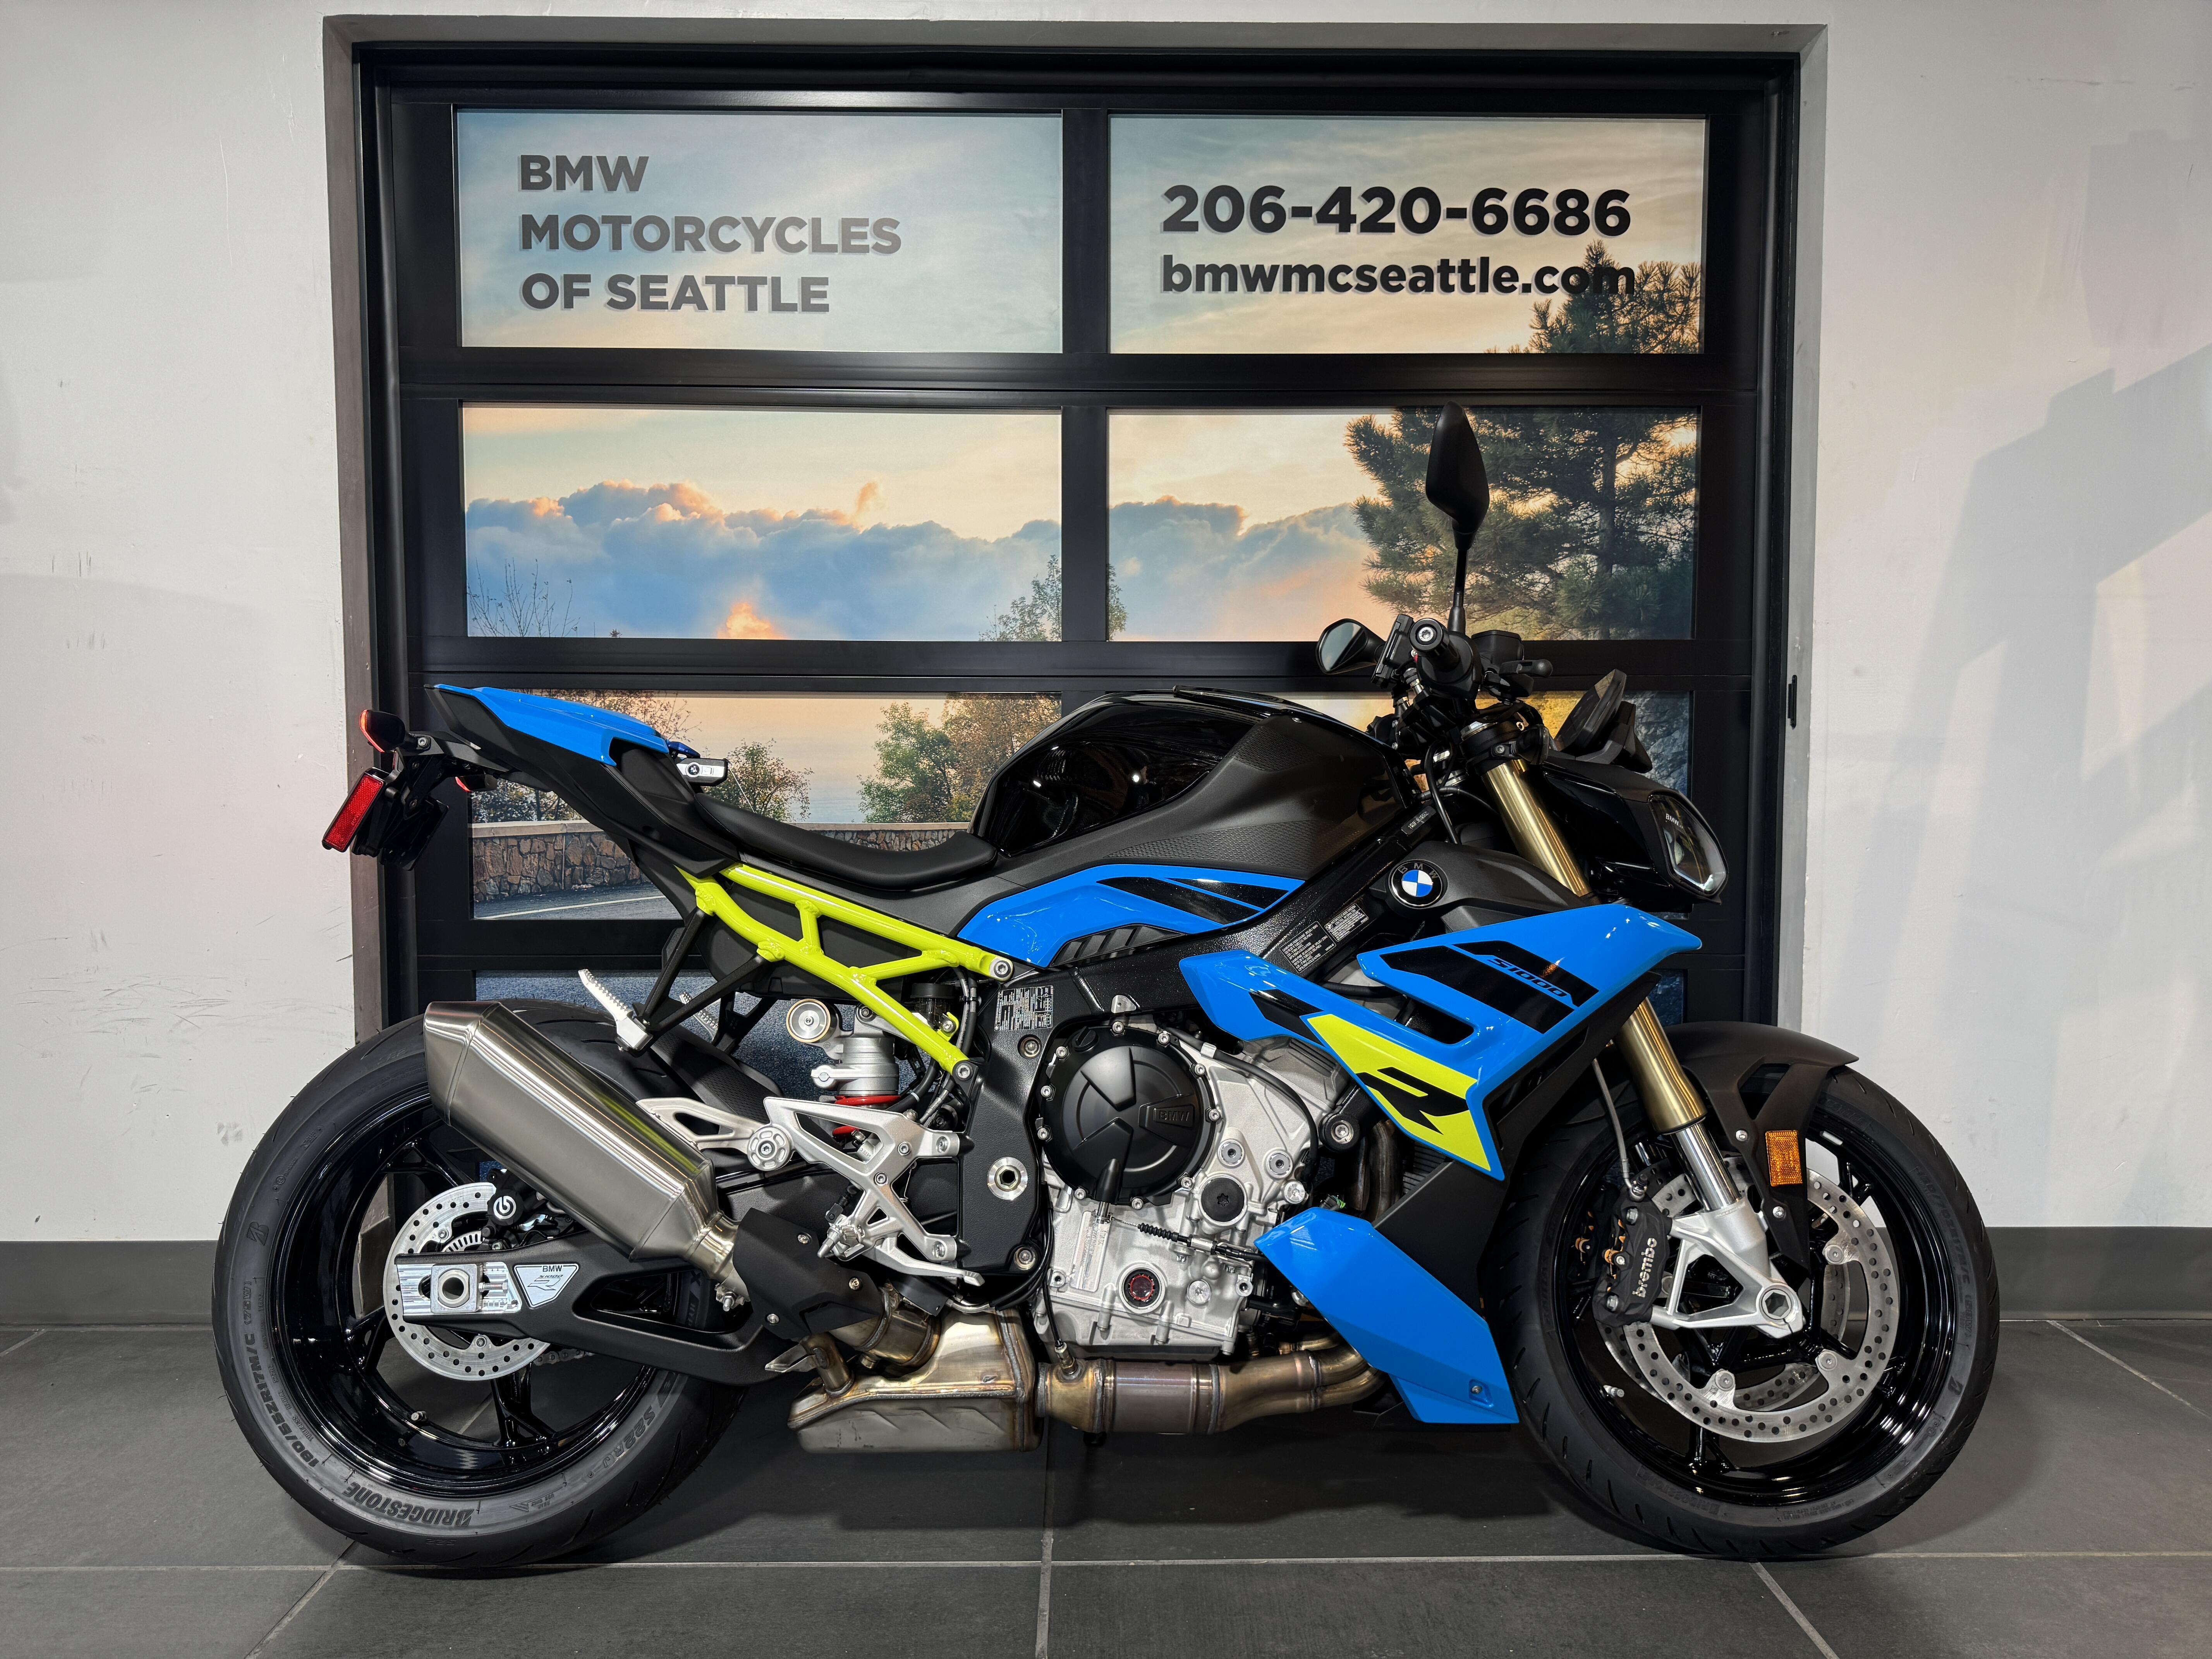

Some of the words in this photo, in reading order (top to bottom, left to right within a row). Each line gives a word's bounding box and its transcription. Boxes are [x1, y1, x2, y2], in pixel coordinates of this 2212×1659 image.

[521, 155, 649, 191] BMW
[1163, 185, 1631, 236] 206-420-6686
[522, 214, 901, 254] MOTORCYCLES
[522, 273, 591, 309] OF
[606, 274, 829, 312] SEATTLE
[1163, 254, 1635, 294] bmwmcseattle.com
[1666, 813, 1679, 826] BMW
[1398, 863, 1438, 879] BMW
[1487, 958, 1567, 997] S1000
[1159, 1110, 1190, 1121] BMW
[1632, 1238, 1657, 1297] brembo
[342, 1480, 474, 1527] BRIDGESTONE
